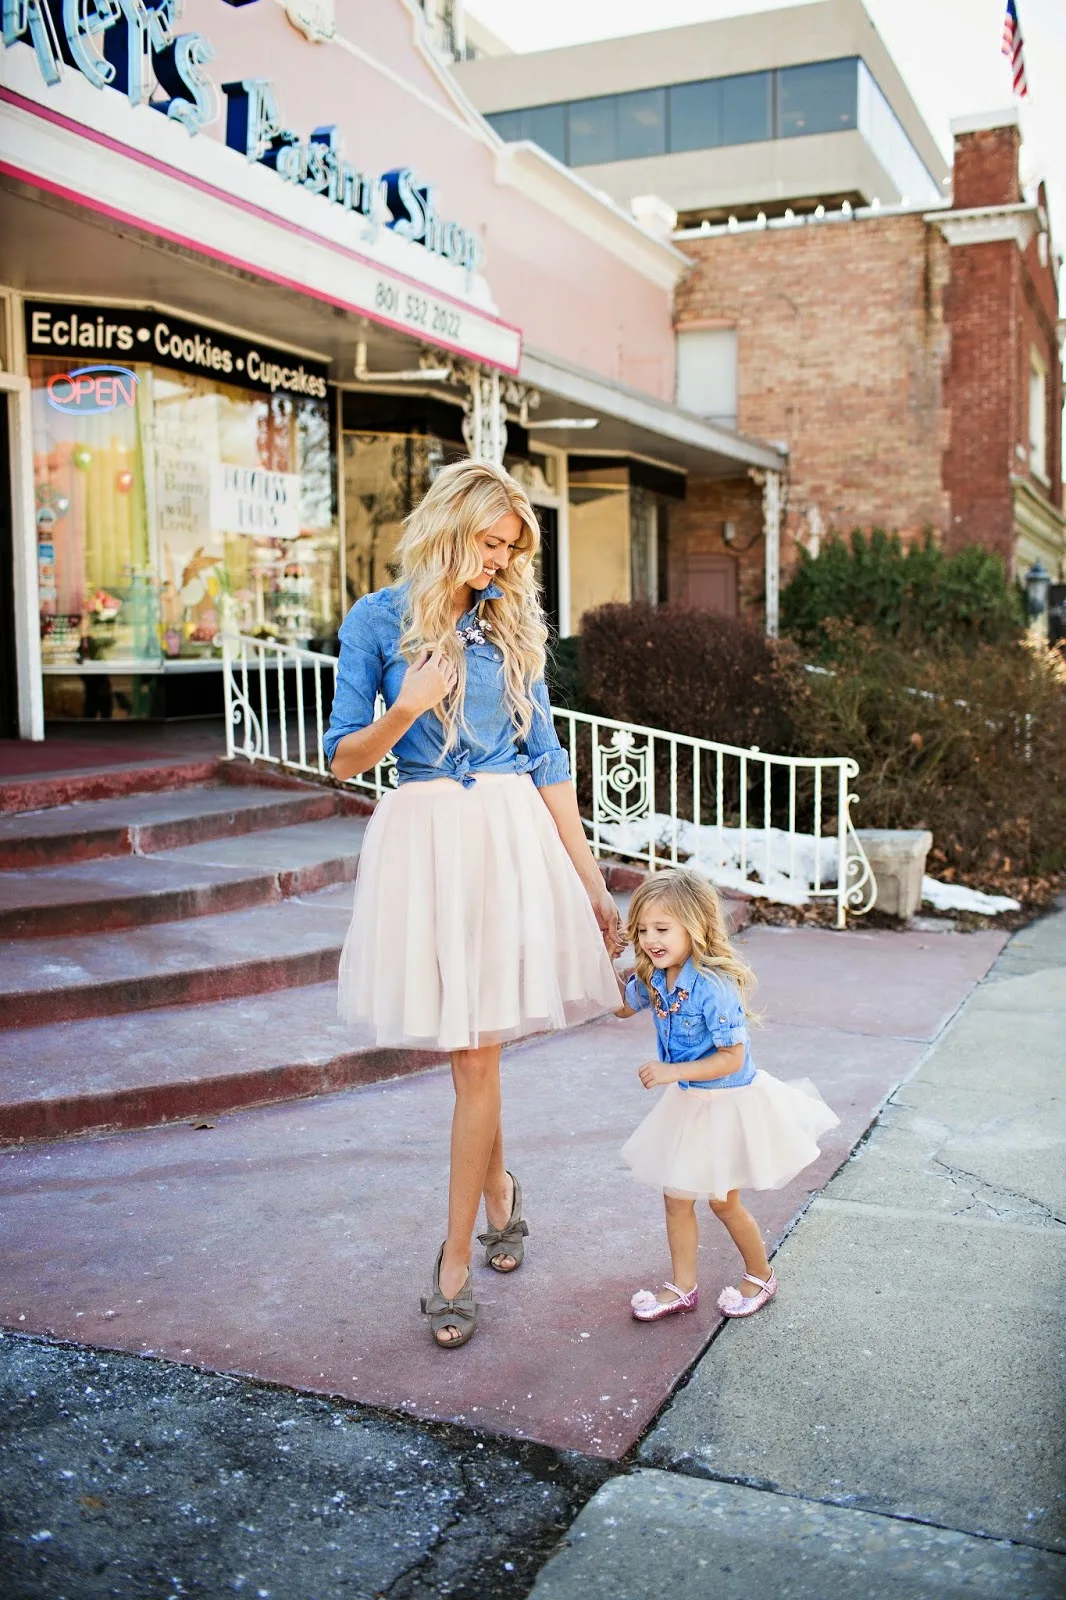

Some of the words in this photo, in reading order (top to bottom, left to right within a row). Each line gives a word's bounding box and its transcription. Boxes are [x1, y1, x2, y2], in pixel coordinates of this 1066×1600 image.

[382, 168, 487, 286] Shop
[375, 281, 399, 312] 801
[404, 294, 428, 325] 532
[432, 305, 462, 338] 2022
[31, 311, 134, 350] Eclairs
[154, 323, 234, 373] Cookies
[246, 351, 327, 398] Cupcakes
[47, 373, 136, 408] OPEN
